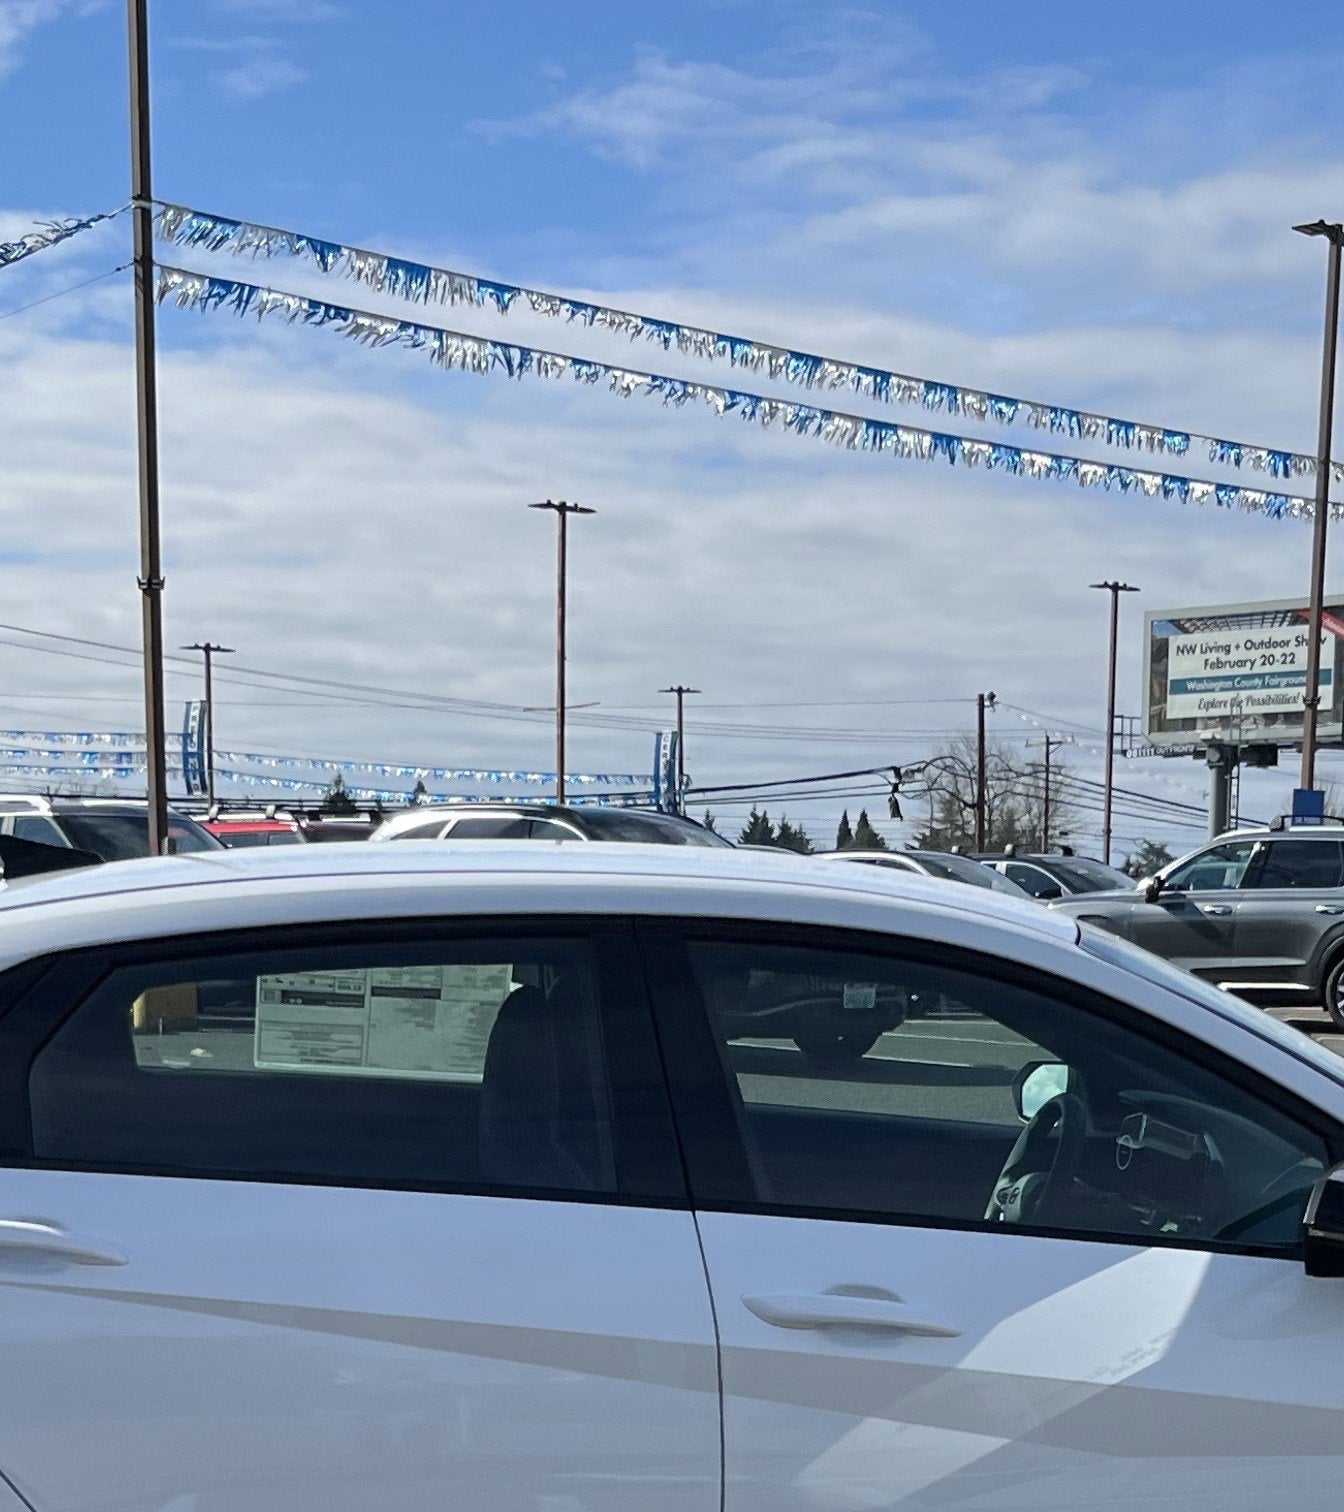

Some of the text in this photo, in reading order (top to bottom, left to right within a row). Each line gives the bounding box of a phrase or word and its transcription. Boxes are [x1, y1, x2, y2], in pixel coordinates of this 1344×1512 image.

[1176, 643, 1197, 656] NW
[1200, 641, 1232, 656] Living
[1244, 636, 1292, 650] Outdoor
[1294, 634, 1327, 648] Shw
[1204, 652, 1296, 671] February 20-22
[1186, 679, 1233, 692] Washington
[1234, 676, 1263, 690] County
